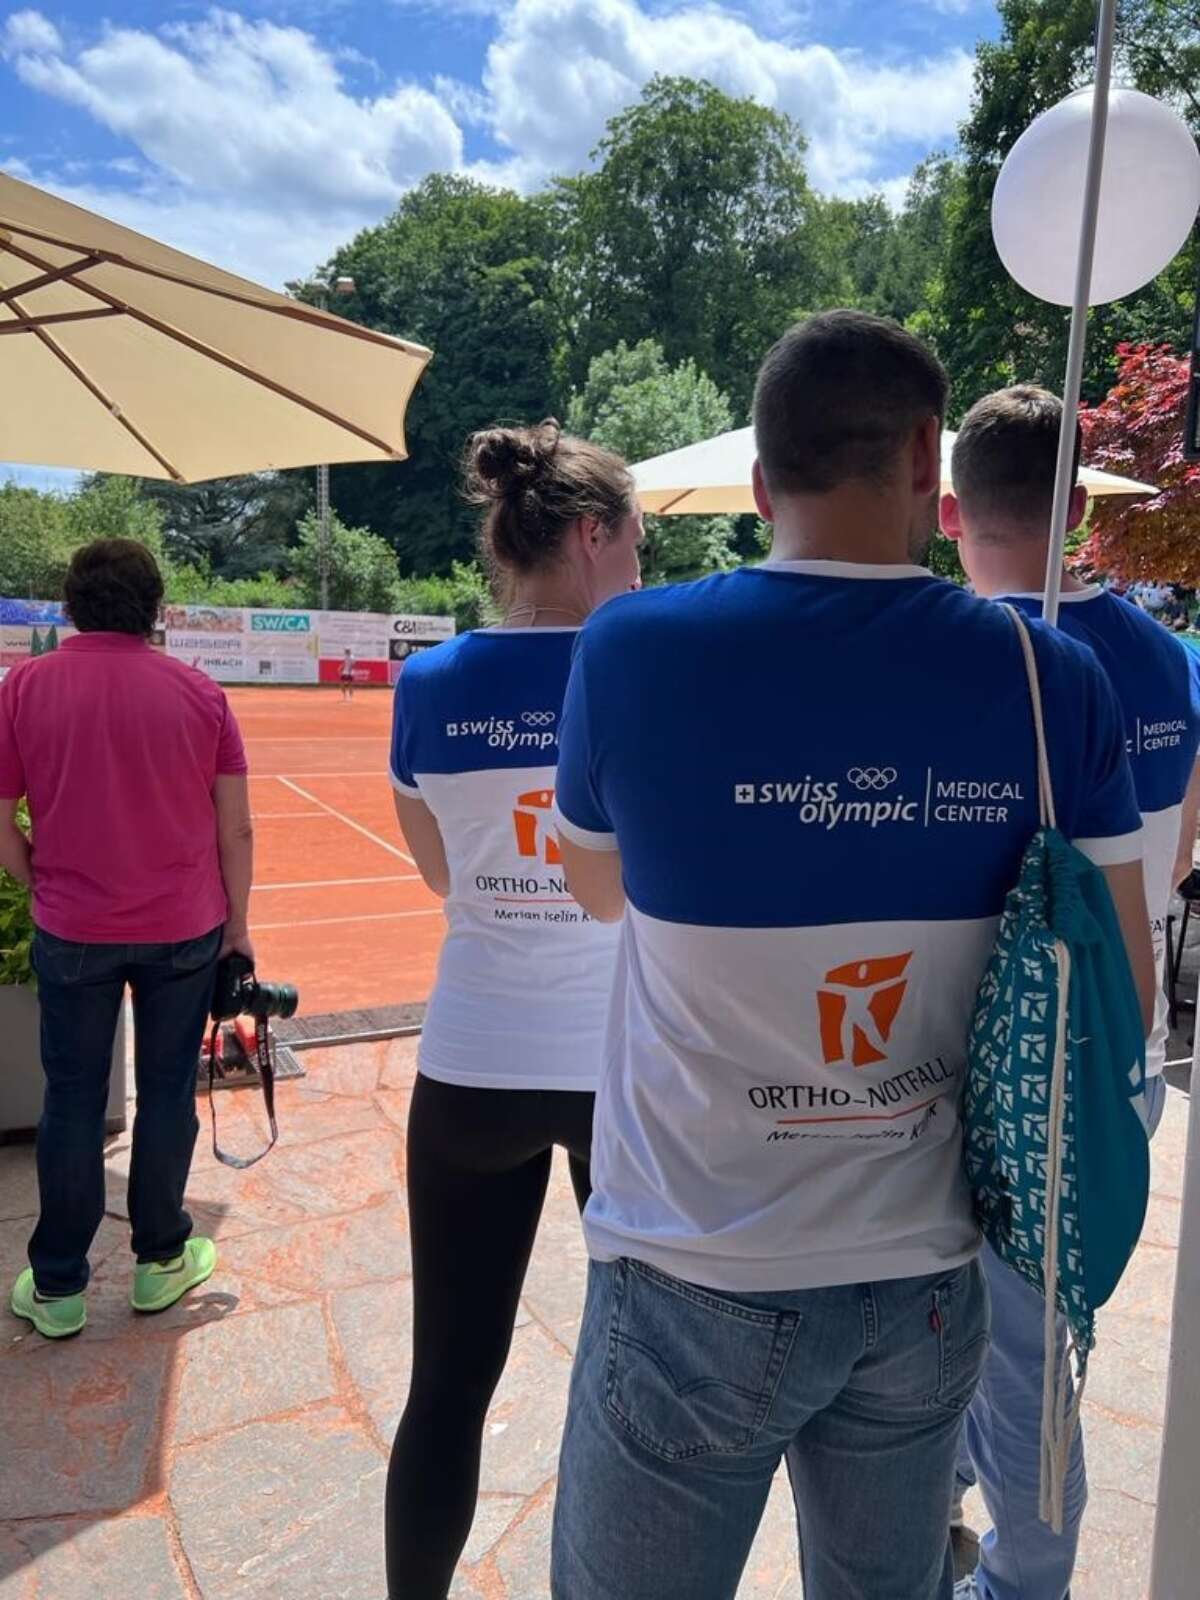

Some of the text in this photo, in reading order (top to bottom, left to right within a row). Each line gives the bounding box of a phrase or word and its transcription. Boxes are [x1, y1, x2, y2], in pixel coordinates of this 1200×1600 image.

[461, 717, 514, 734] swiss
[1143, 719, 1188, 736] MEDICAL
[488, 729, 559, 750] olymp
[1143, 734, 1181, 751] CENTER
[759, 775, 838, 803] swiss
[936, 781, 1024, 800] MEDICAL
[800, 795, 918, 830] olympic
[934, 804, 1009, 823] CENTER
[475, 875, 571, 894] ORTHO-N
[494, 908, 541, 920] Merian
[748, 1057, 954, 1110] ORTHO-NOTFALL
